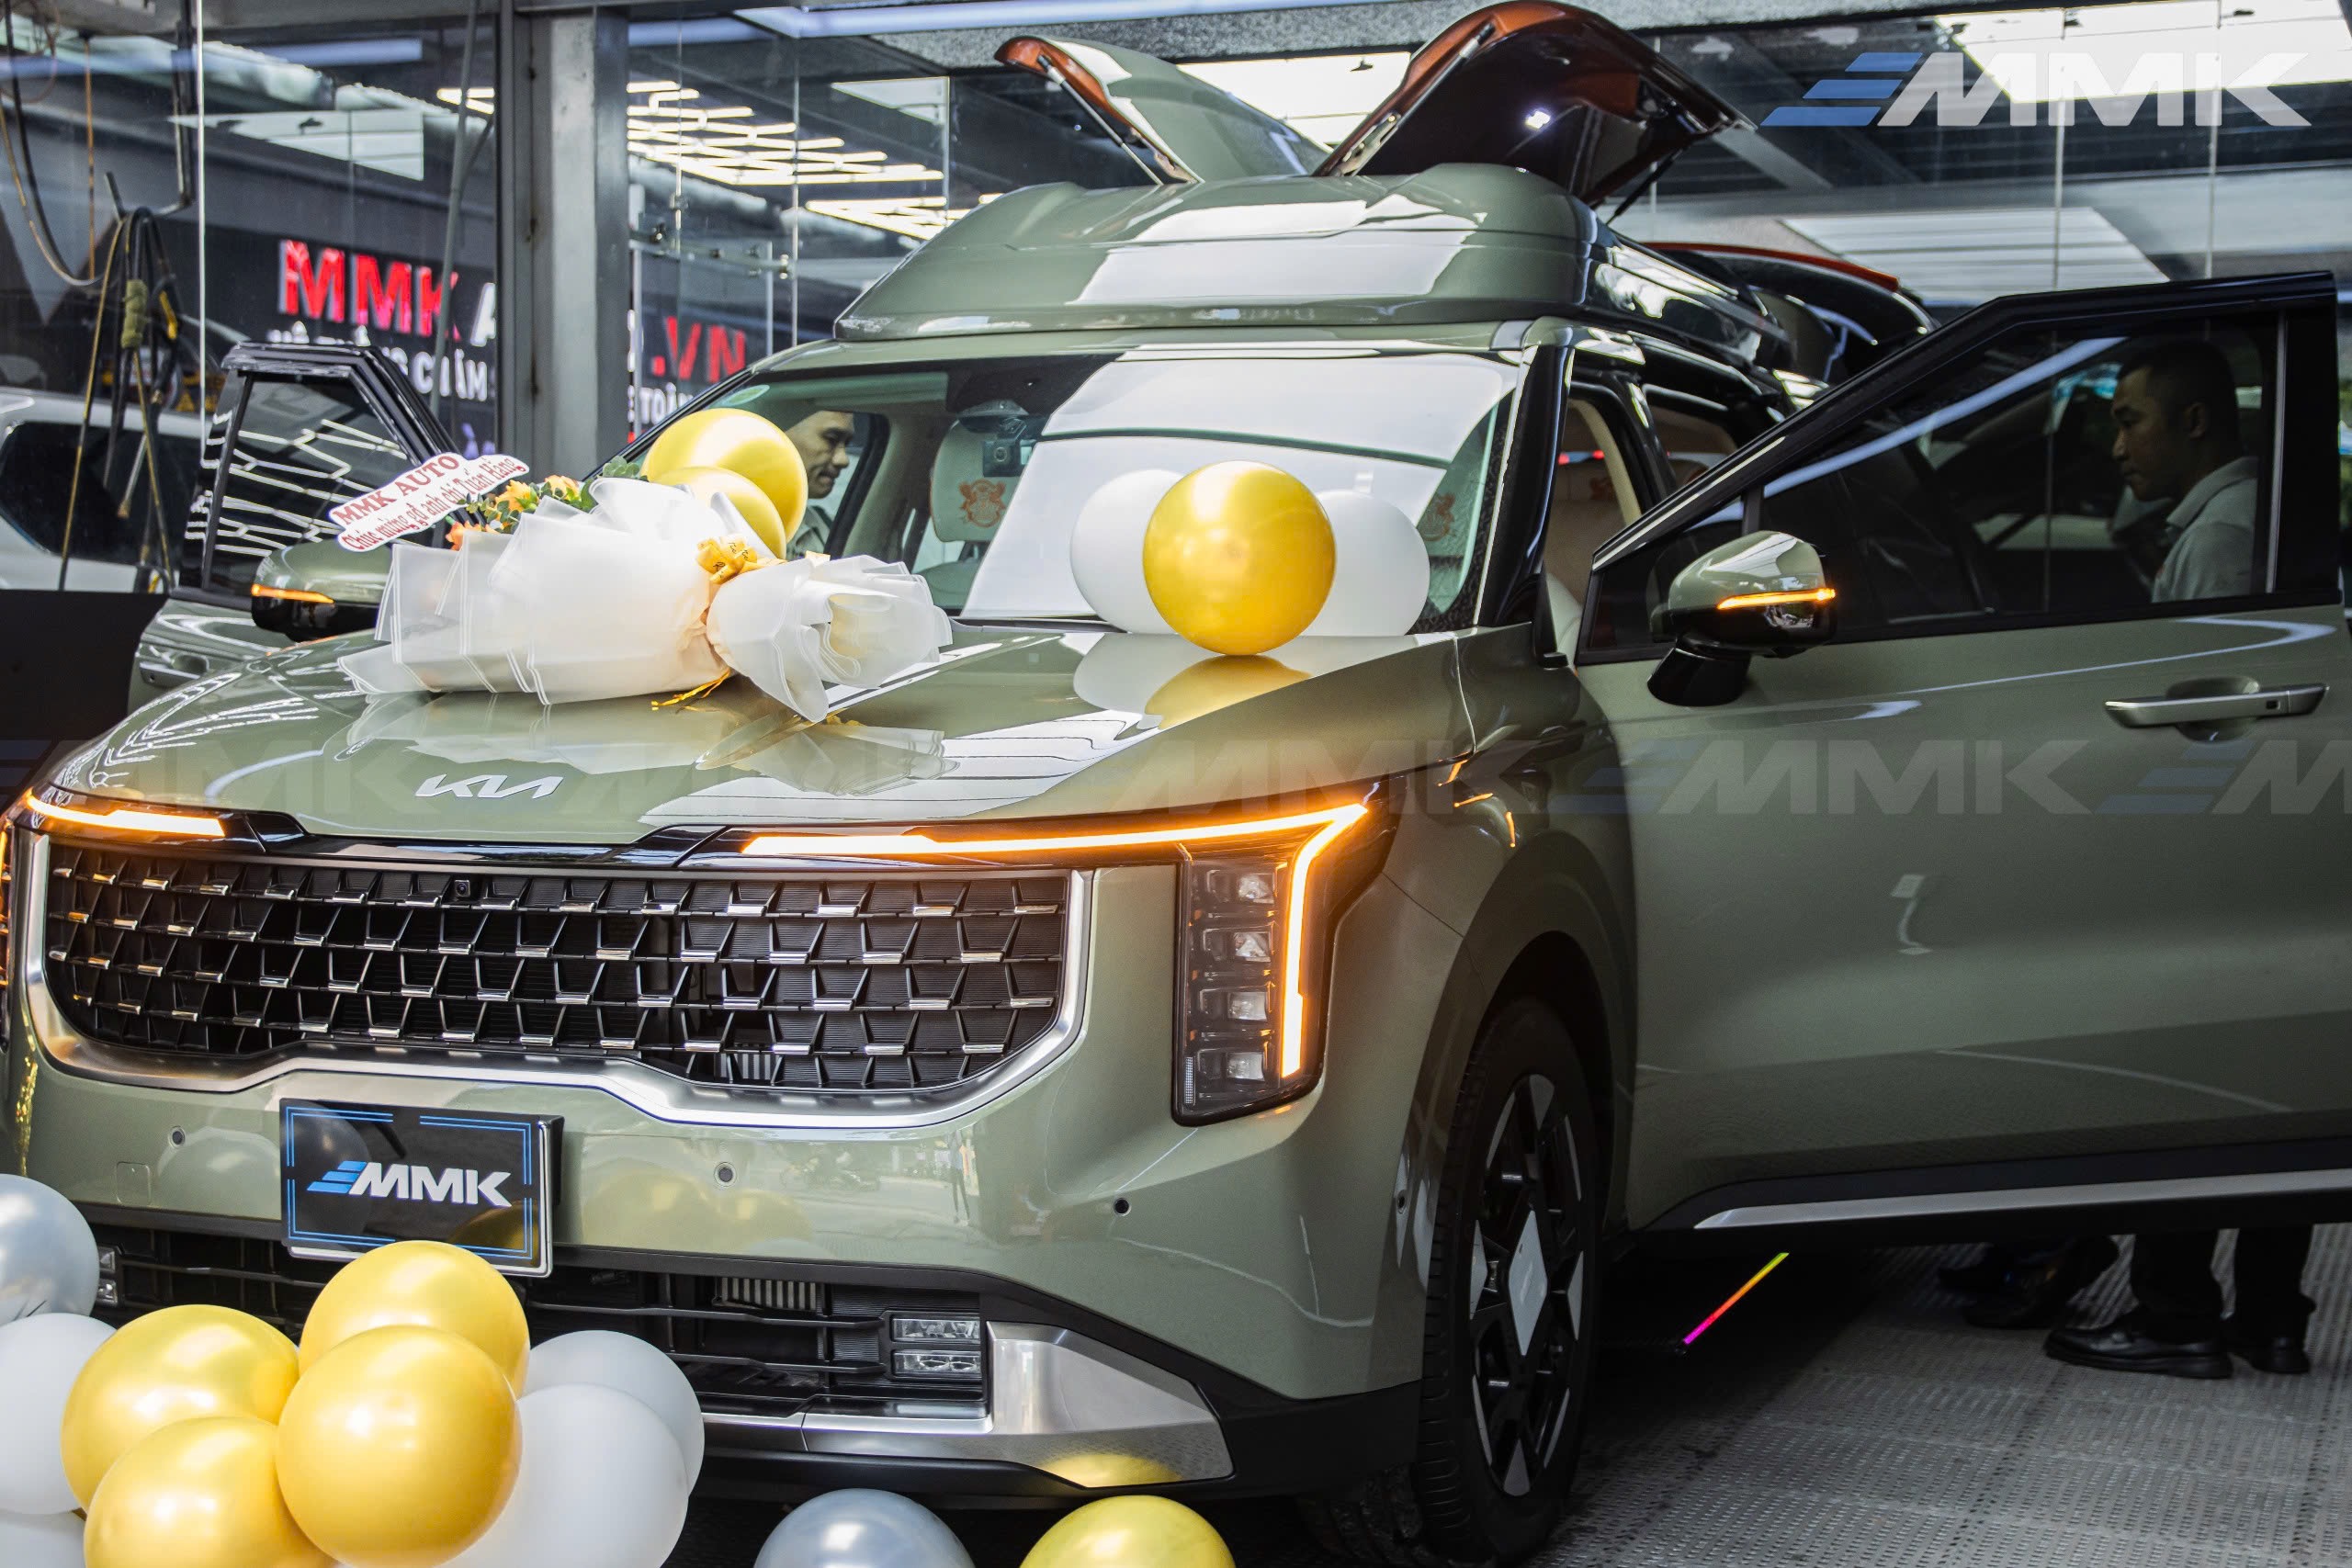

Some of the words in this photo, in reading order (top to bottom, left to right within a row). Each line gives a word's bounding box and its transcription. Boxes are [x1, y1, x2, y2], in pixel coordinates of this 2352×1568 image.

[280, 239, 462, 342] MMK
[333, 491, 397, 525] MMK
[395, 456, 459, 497] AUTO
[421, 493, 451, 515] anh
[349, 1162, 513, 1207] MMK
